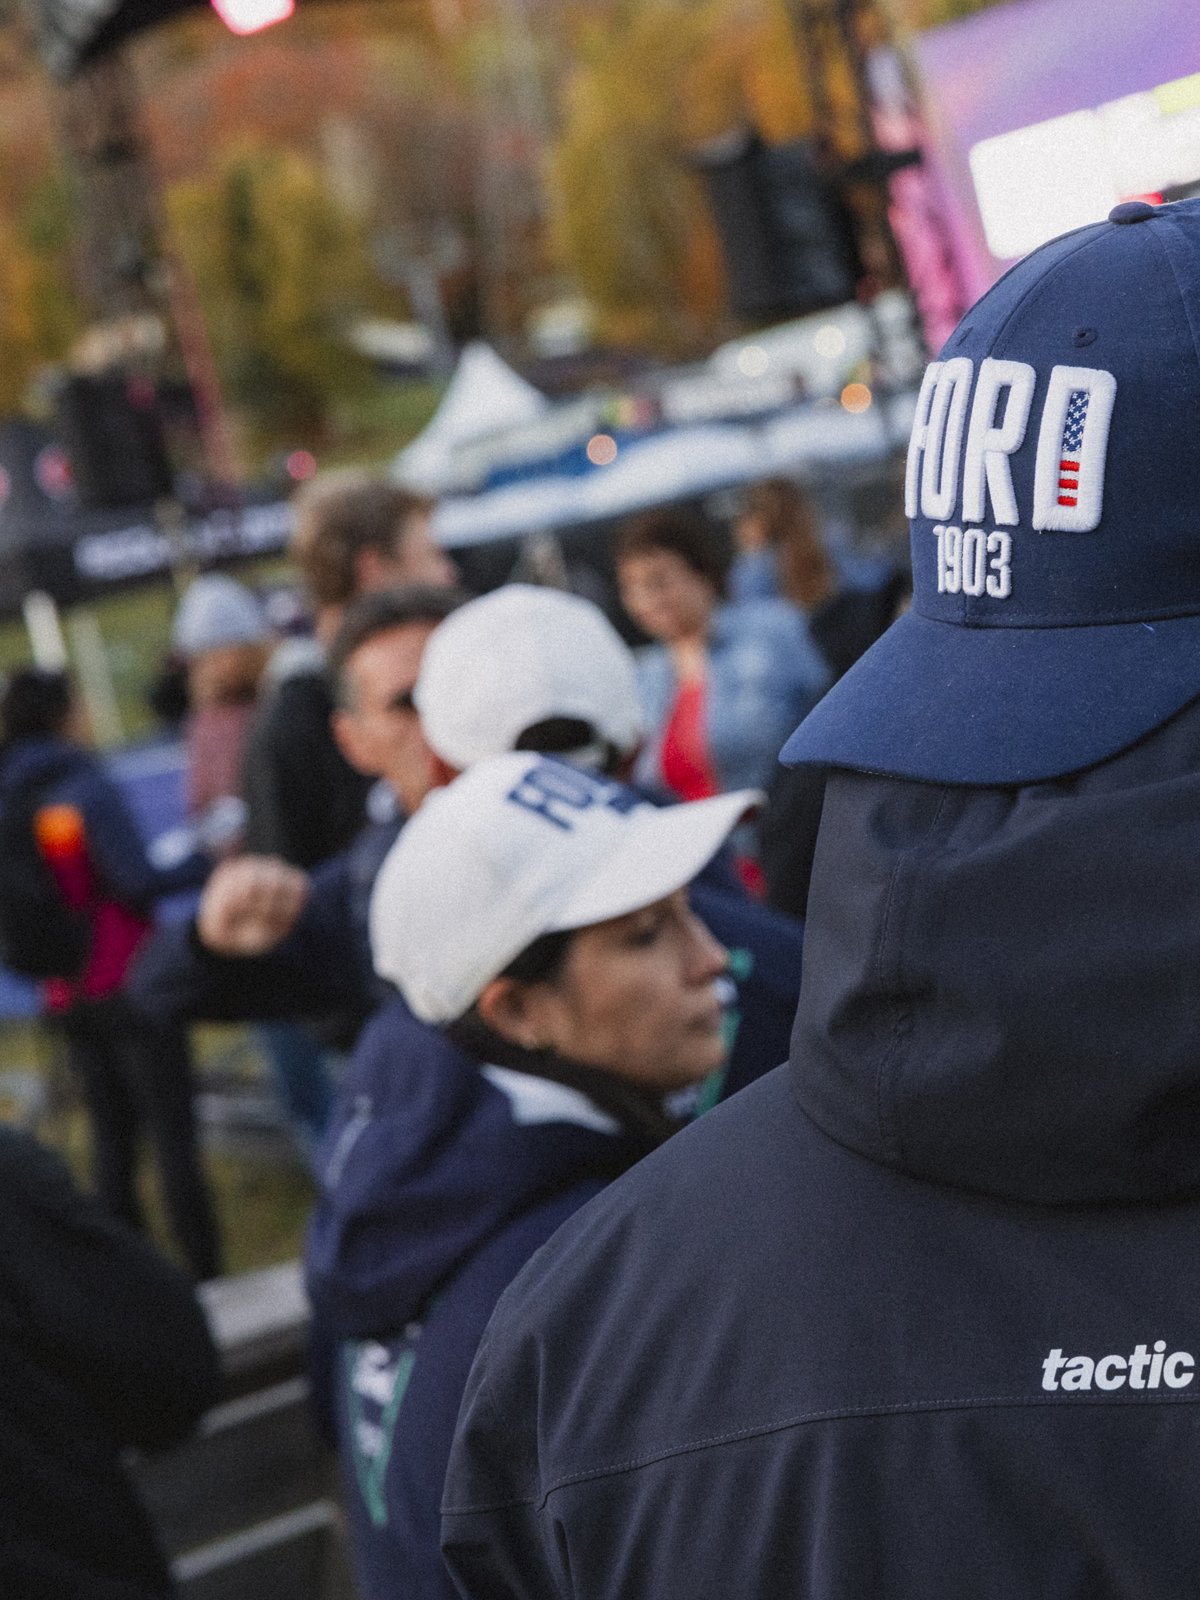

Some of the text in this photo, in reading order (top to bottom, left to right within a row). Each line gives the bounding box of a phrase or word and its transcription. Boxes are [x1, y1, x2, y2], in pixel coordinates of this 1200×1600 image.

[904, 356, 1118, 533] FORD
[932, 524, 1013, 600] 1903
[1041, 1339, 1196, 1392] tactic
